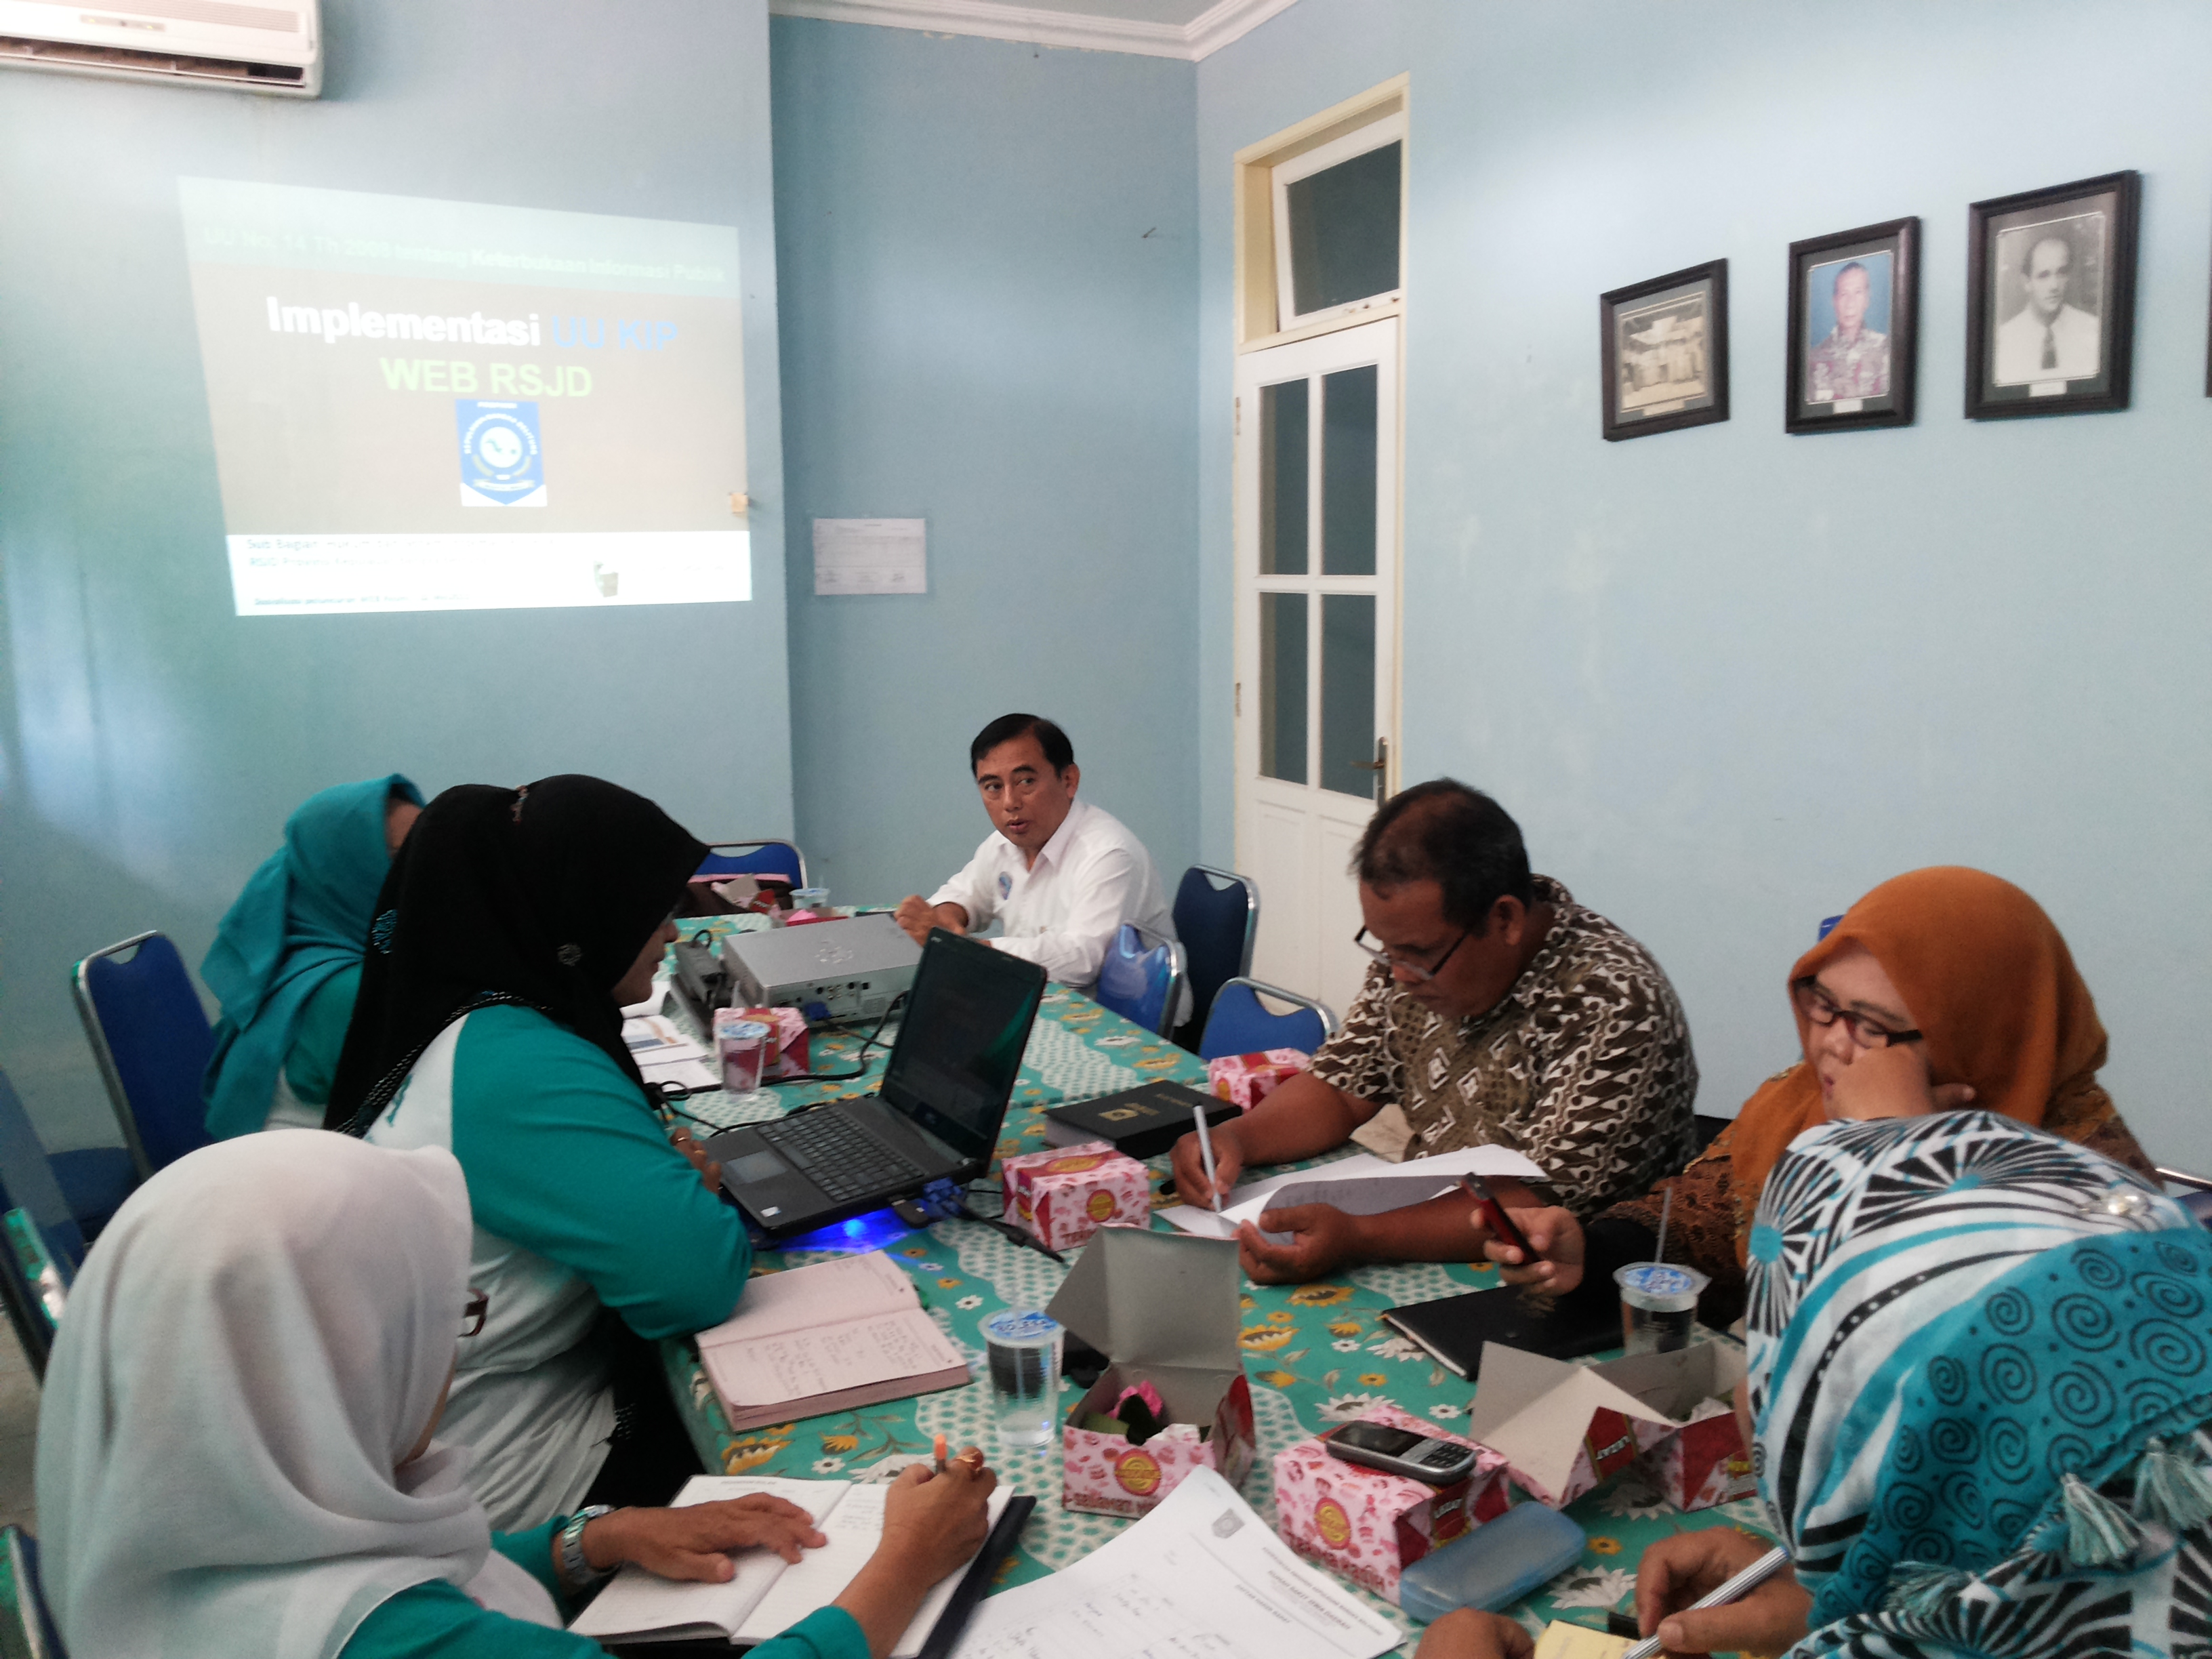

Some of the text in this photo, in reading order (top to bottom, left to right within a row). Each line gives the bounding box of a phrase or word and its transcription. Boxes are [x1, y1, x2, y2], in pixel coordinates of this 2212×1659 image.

[395, 243, 468, 268] tentang
[470, 248, 588, 272] Keterbukaan
[589, 258, 671, 279] Informasi
[673, 263, 726, 282] Publik
[266, 296, 678, 351] Implementasi UU KIP
[379, 356, 593, 397] WEB RSJD
